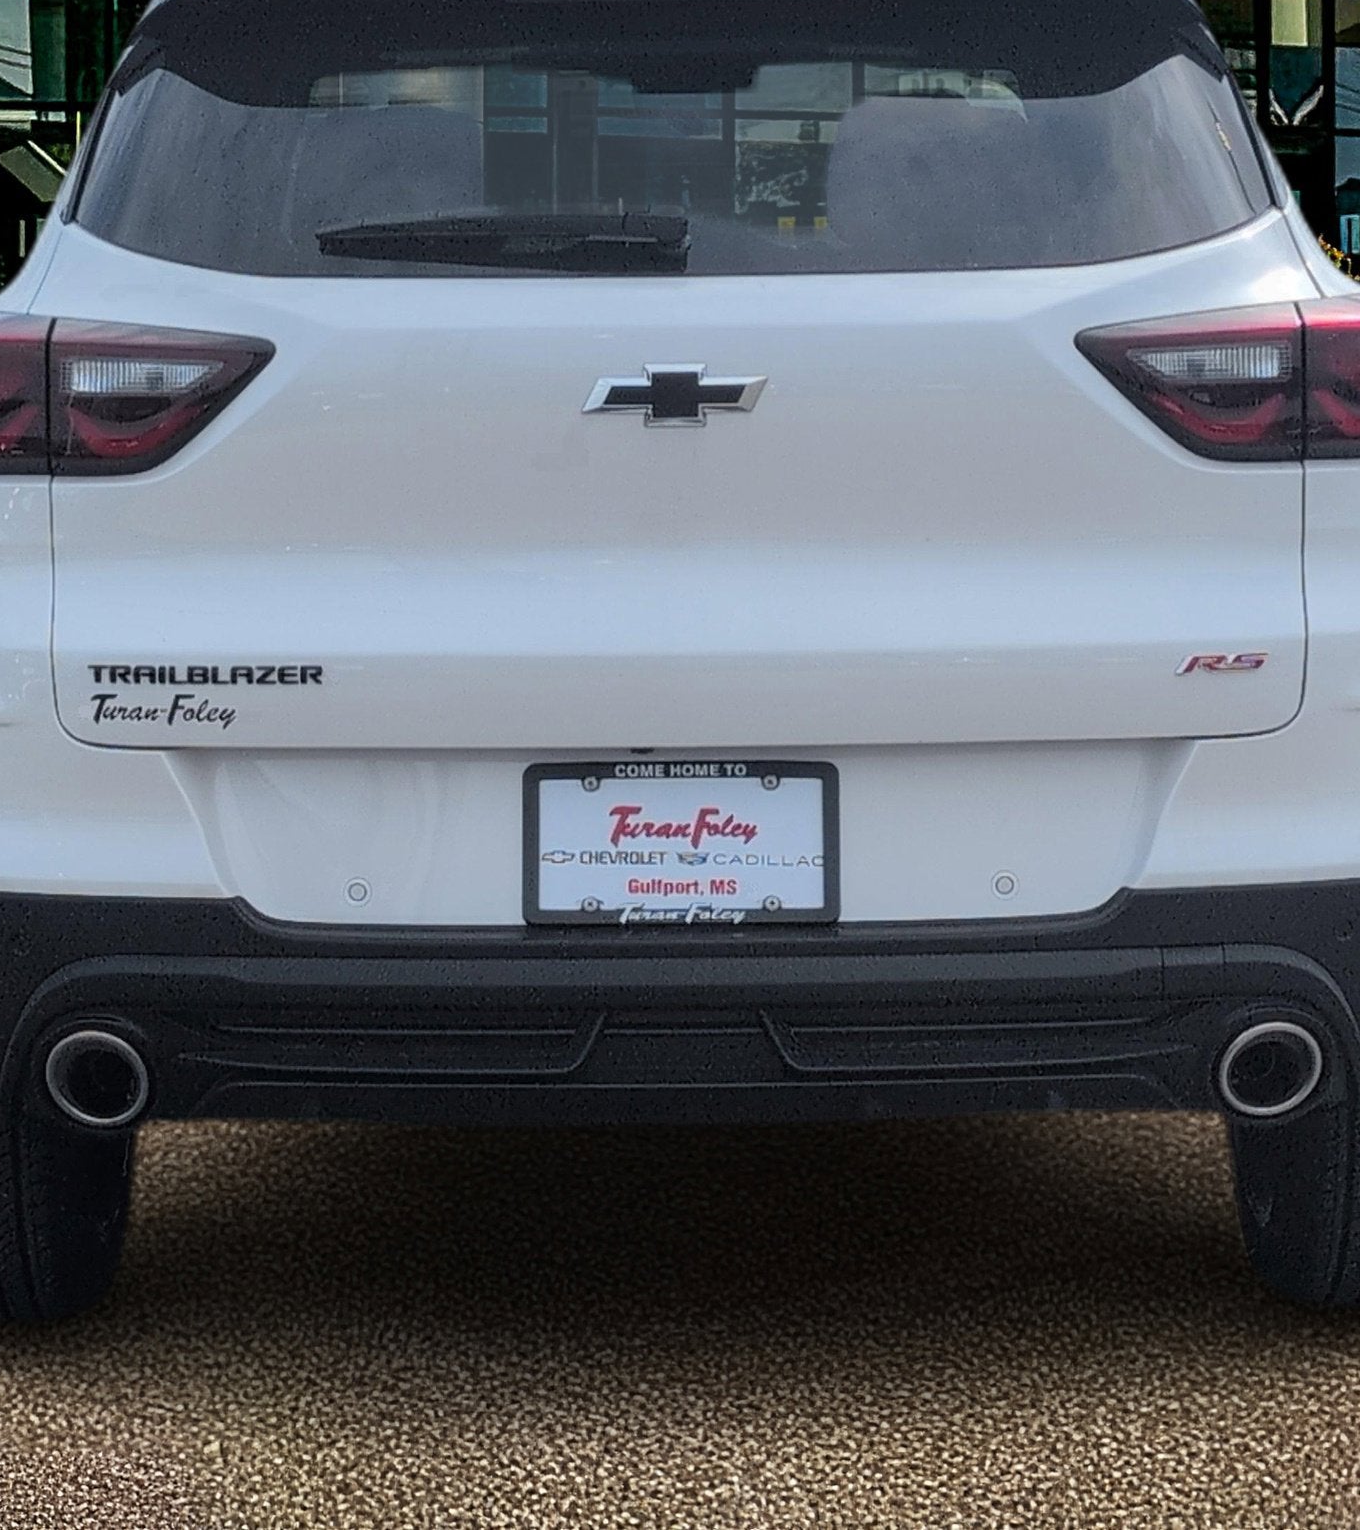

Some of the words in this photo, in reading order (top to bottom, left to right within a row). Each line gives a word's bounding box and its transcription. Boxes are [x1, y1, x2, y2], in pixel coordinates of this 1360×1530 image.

[1174, 653, 1270, 676] RS
[88, 664, 323, 685] TRAILBLAZER
[614, 763, 665, 778] COME
[670, 763, 722, 778] HOME
[725, 763, 747, 777] TO
[579, 850, 668, 866] CHEVROLET
[712, 853, 824, 868] CADILLAC
[627, 878, 705, 897] Gulfport,
[709, 878, 738, 896] MS
